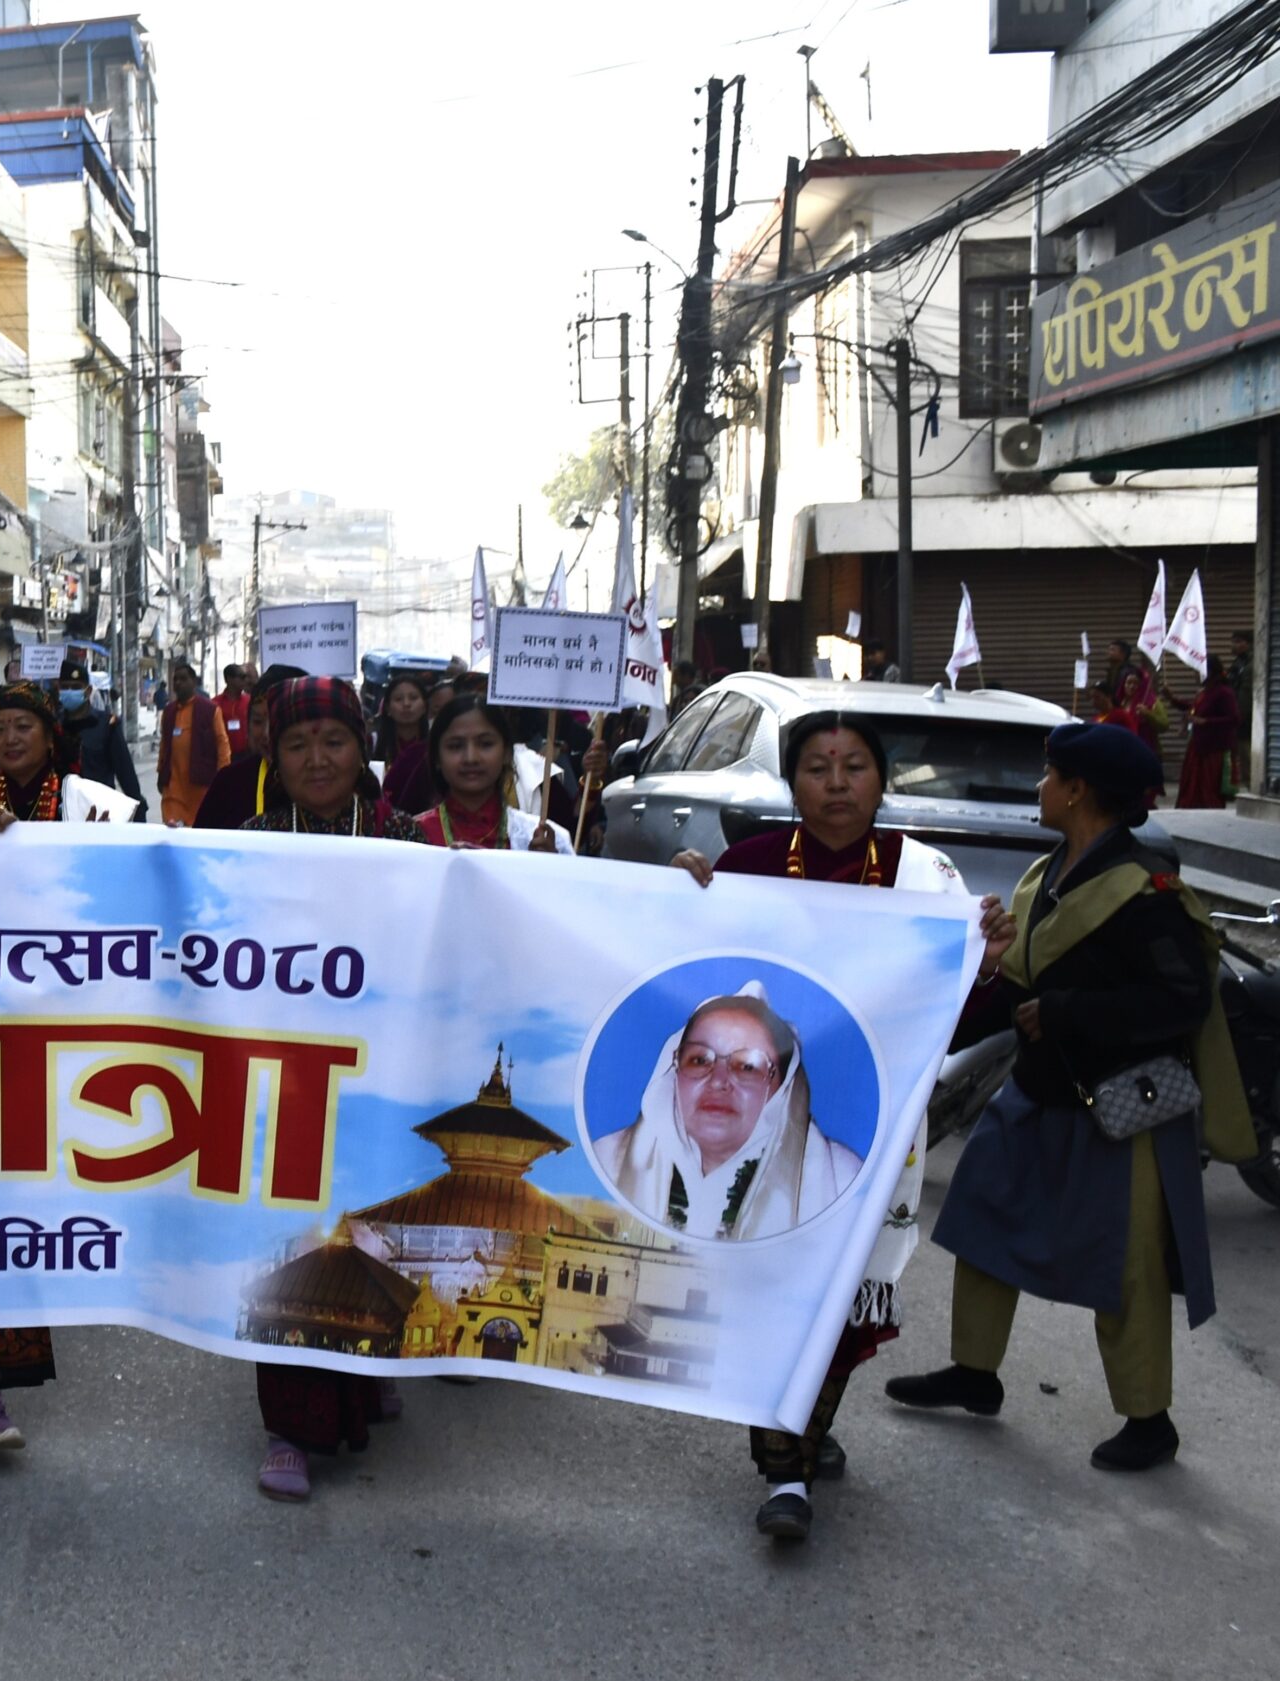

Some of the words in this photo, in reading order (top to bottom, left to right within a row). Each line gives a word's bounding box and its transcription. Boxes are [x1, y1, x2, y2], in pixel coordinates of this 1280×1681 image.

[1041, 221, 1276, 387] एपियरेन्स
[523, 634, 557, 649] मानव
[563, 633, 582, 650] धर्म
[503, 651, 559, 671] मानिसको
[564, 654, 584, 672] धर्म
